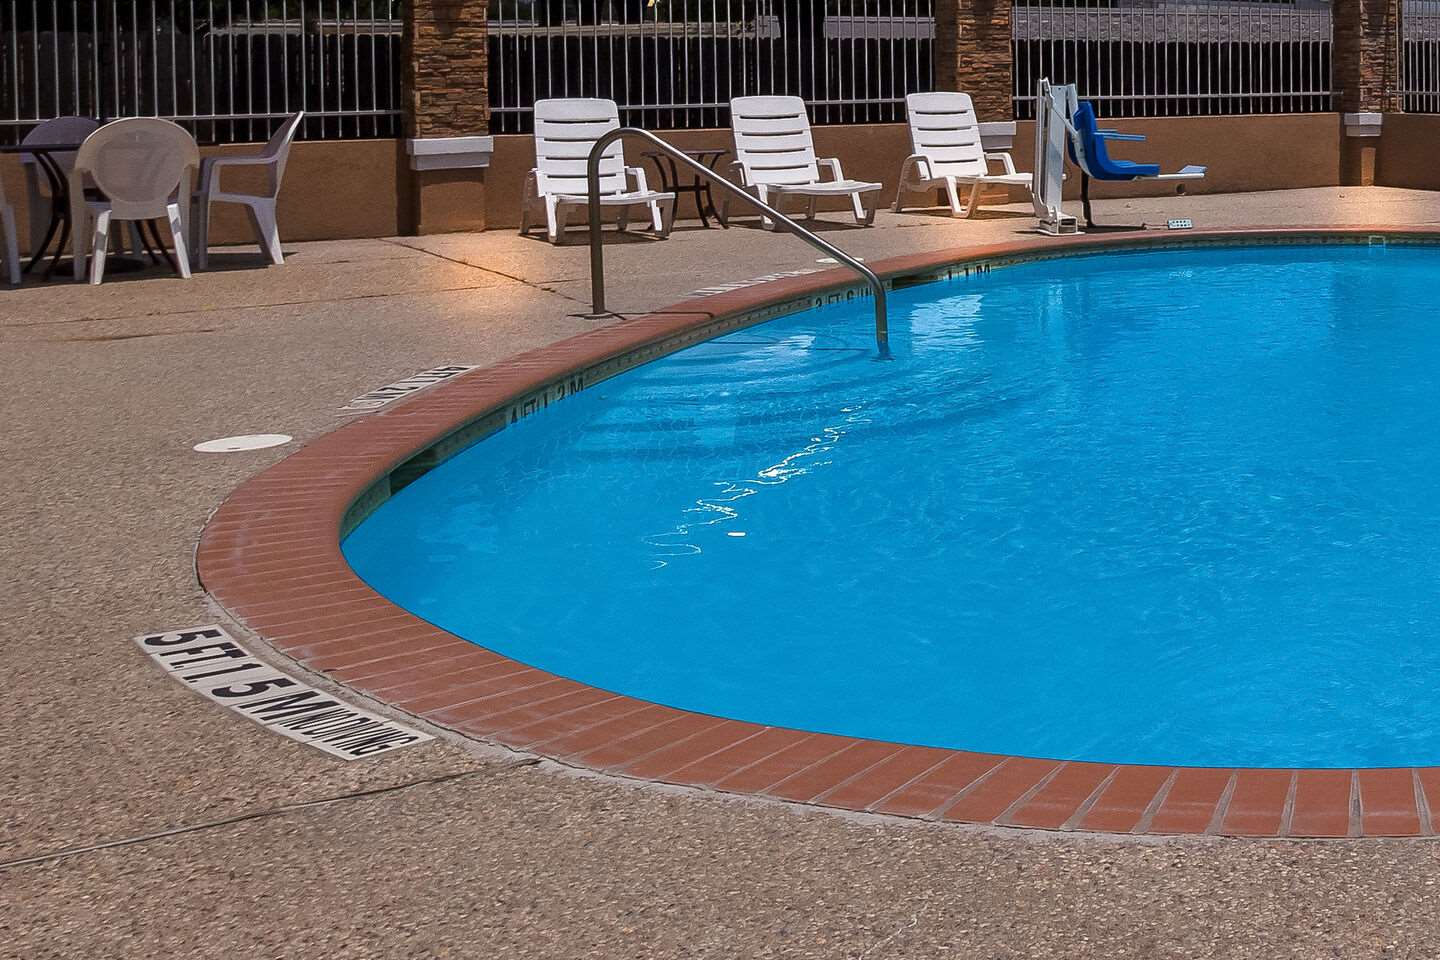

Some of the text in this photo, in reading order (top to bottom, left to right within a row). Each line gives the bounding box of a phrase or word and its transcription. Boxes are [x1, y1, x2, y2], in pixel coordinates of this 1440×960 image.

[144, 628, 223, 647] 5
[278, 707, 359, 731] NO
[300, 717, 420, 756] DIVING
